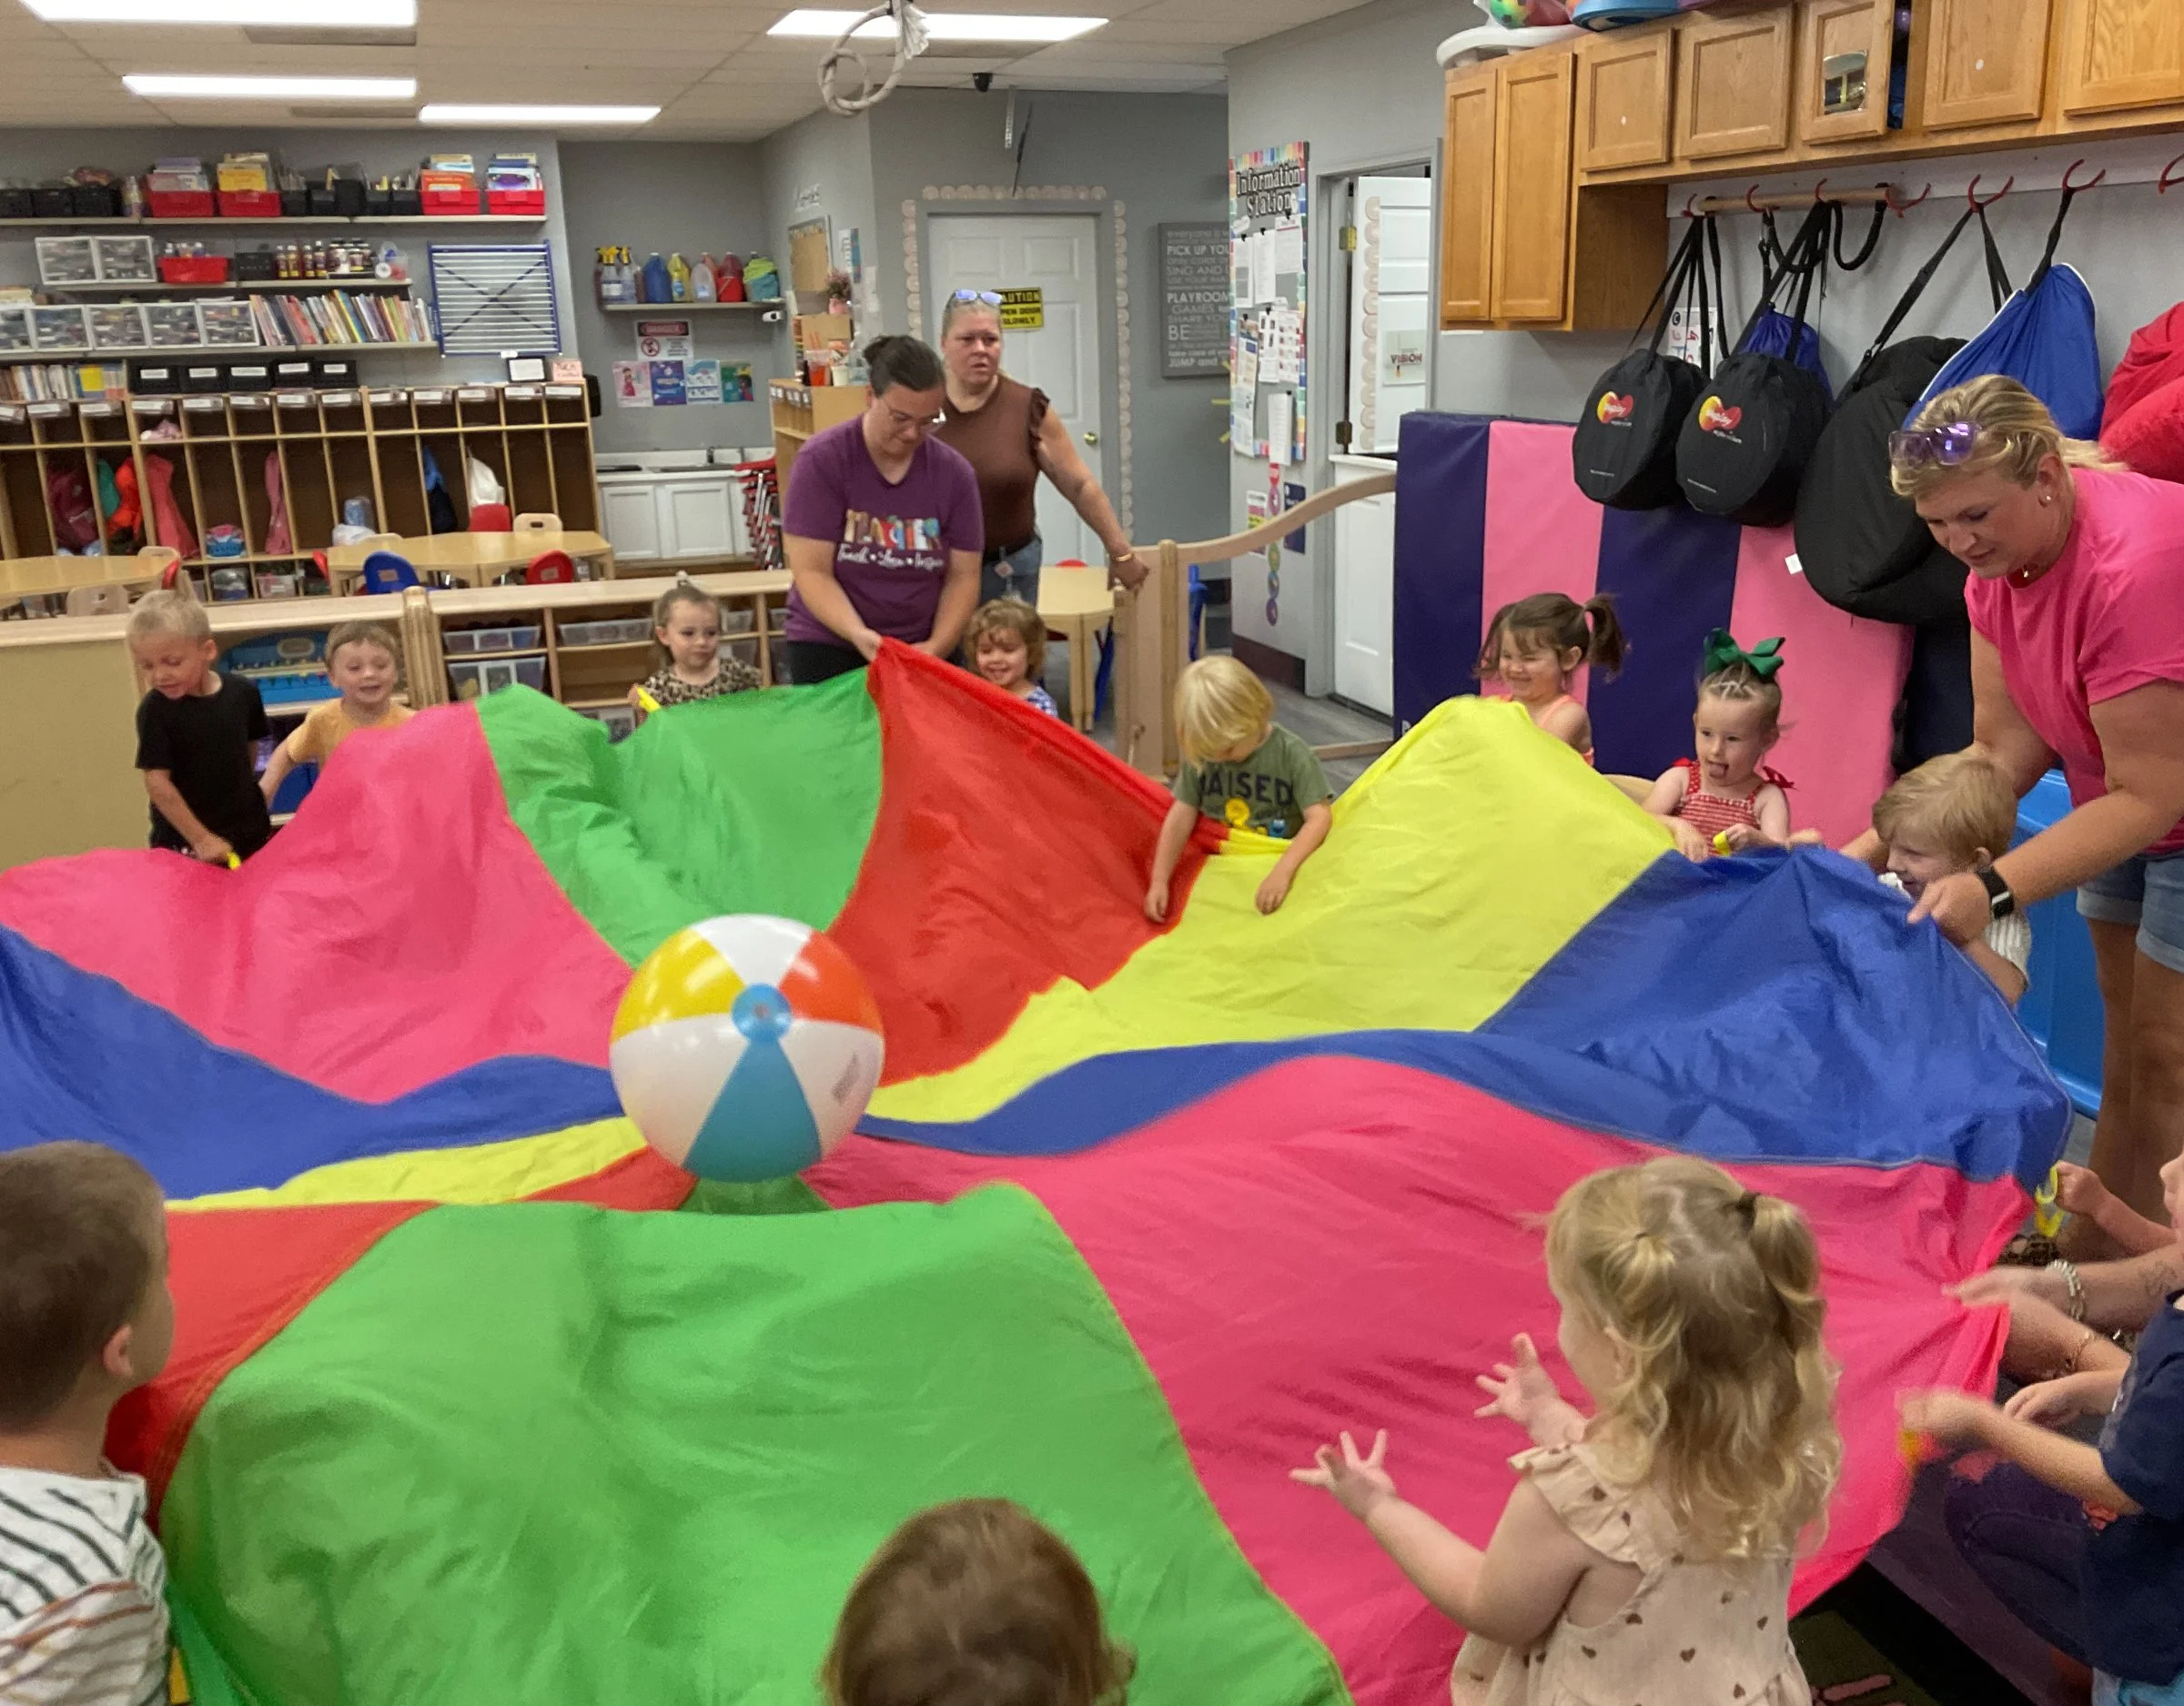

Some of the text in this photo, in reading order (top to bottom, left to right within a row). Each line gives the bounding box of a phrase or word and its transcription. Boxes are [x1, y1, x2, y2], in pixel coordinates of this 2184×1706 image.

[1237, 165, 1301, 197] Information
[1247, 192, 1292, 218] Station
[1167, 245, 1191, 256] PICK
[1194, 245, 1208, 255] UP
[1197, 266, 1222, 275] AND
[1001, 292, 1039, 303] AUTION
[1168, 324, 1190, 341] BE
